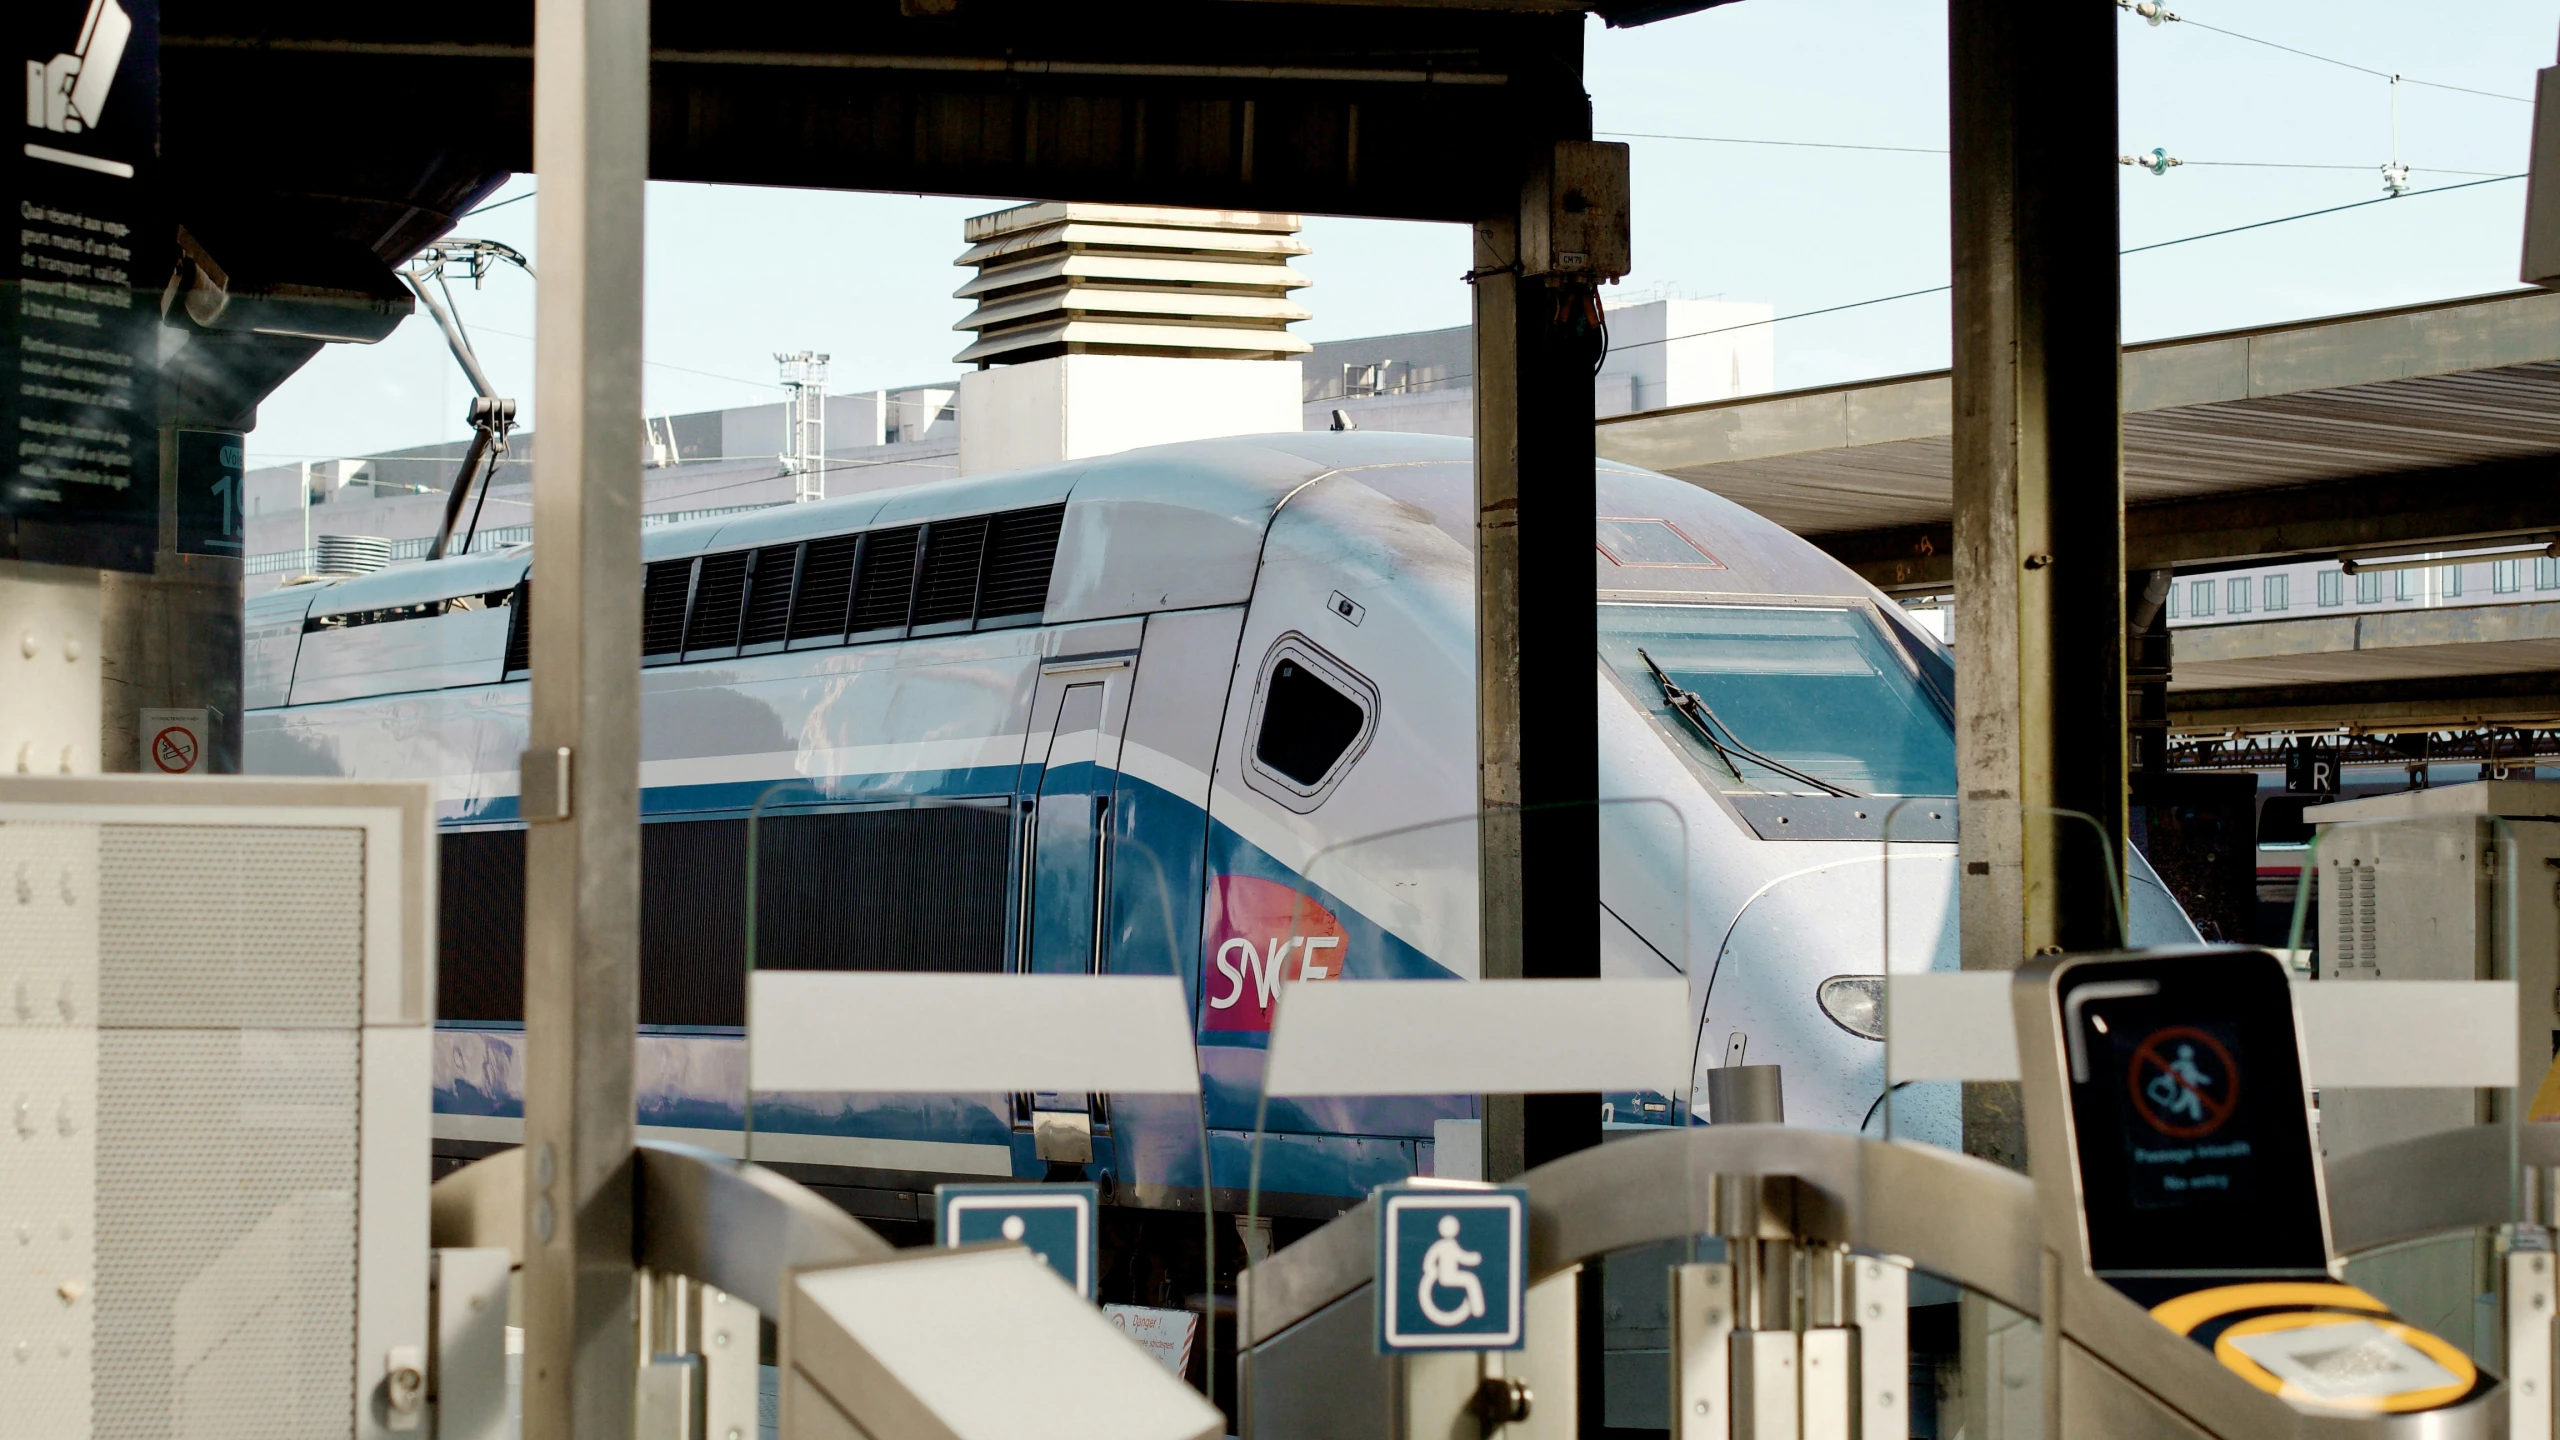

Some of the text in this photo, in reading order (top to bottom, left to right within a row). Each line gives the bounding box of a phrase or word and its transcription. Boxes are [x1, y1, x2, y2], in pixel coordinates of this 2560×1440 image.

[21, 200, 45, 220] Quai
[21, 251, 36, 267] de
[2313, 762, 2330, 791] R
[1210, 936, 1340, 1009] SNCF
[2162, 1173, 2188, 1191] No
[1133, 1314, 1157, 1331] Danger
